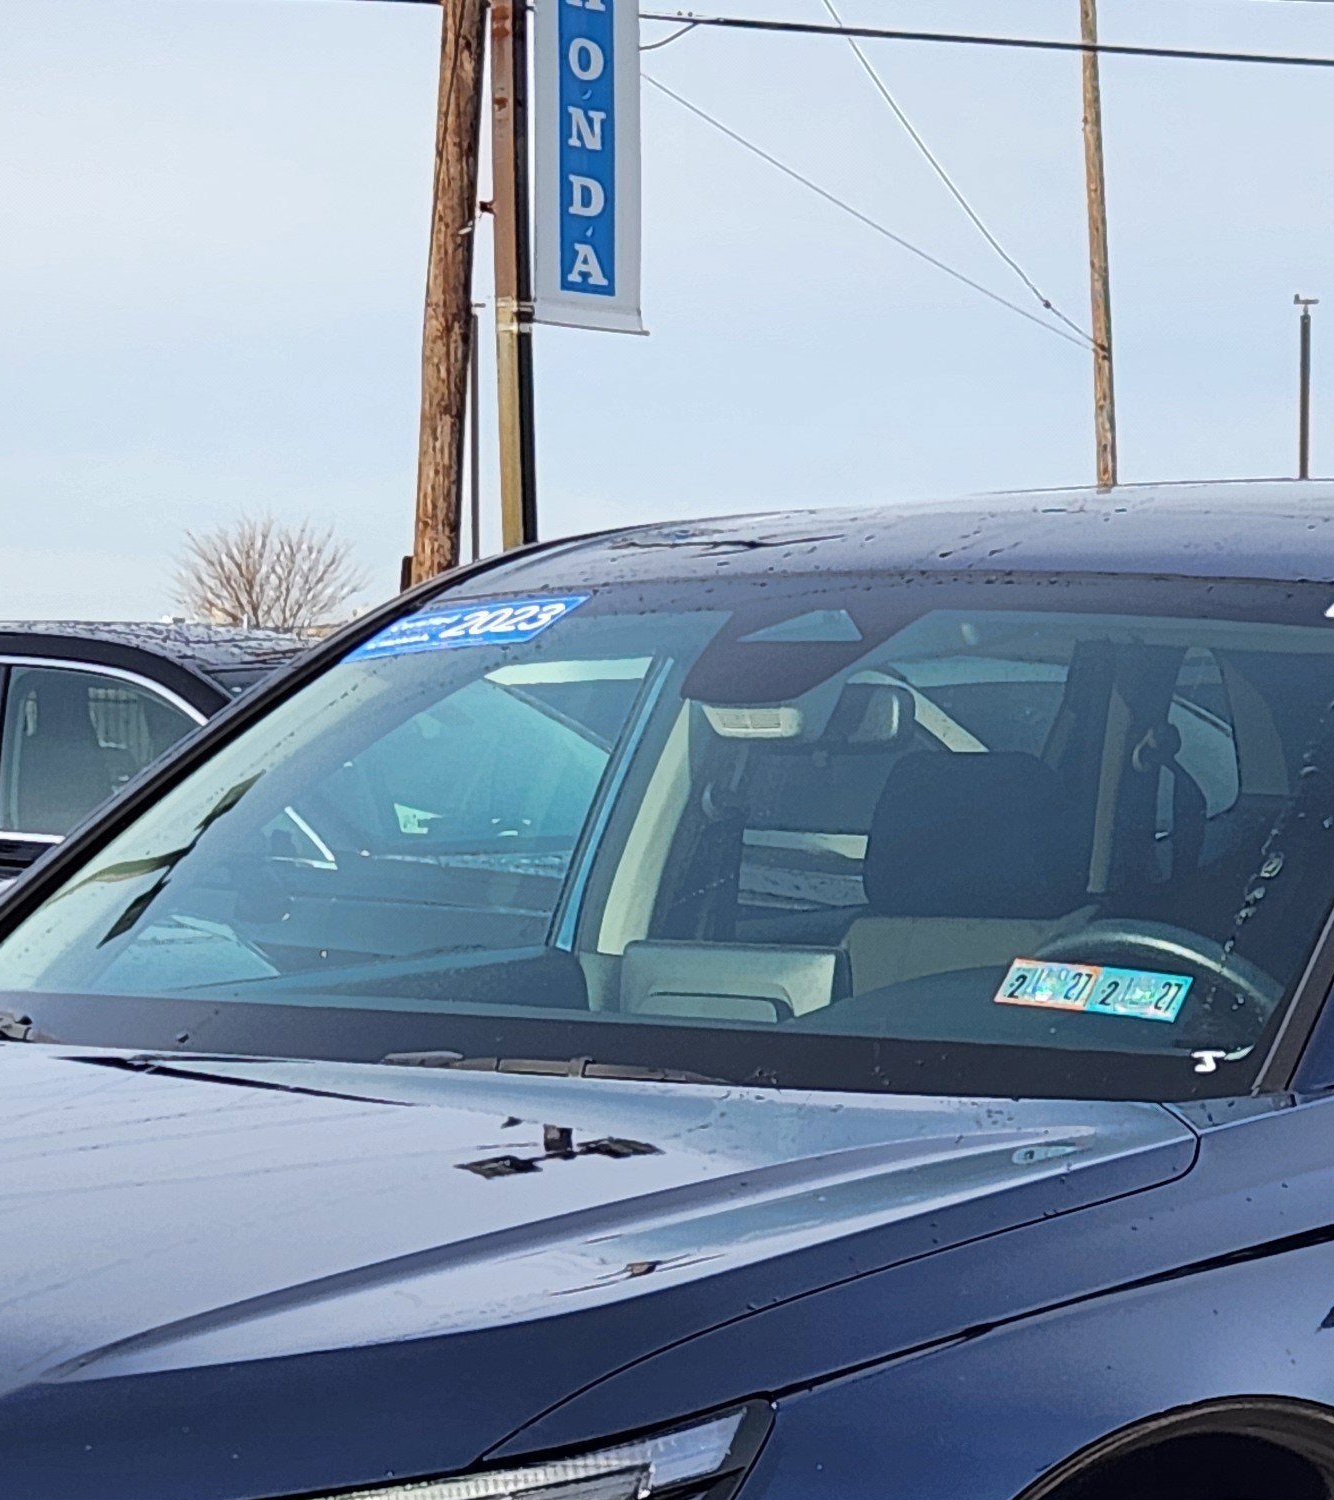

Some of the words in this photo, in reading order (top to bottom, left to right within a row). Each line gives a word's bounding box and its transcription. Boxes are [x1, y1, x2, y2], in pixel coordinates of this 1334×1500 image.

[439, 602, 566, 639] 2023
[1007, 973, 1028, 999] 2
[1063, 971, 1094, 1003] 27
[1098, 980, 1120, 1006] 2
[1154, 981, 1184, 1013] 27
